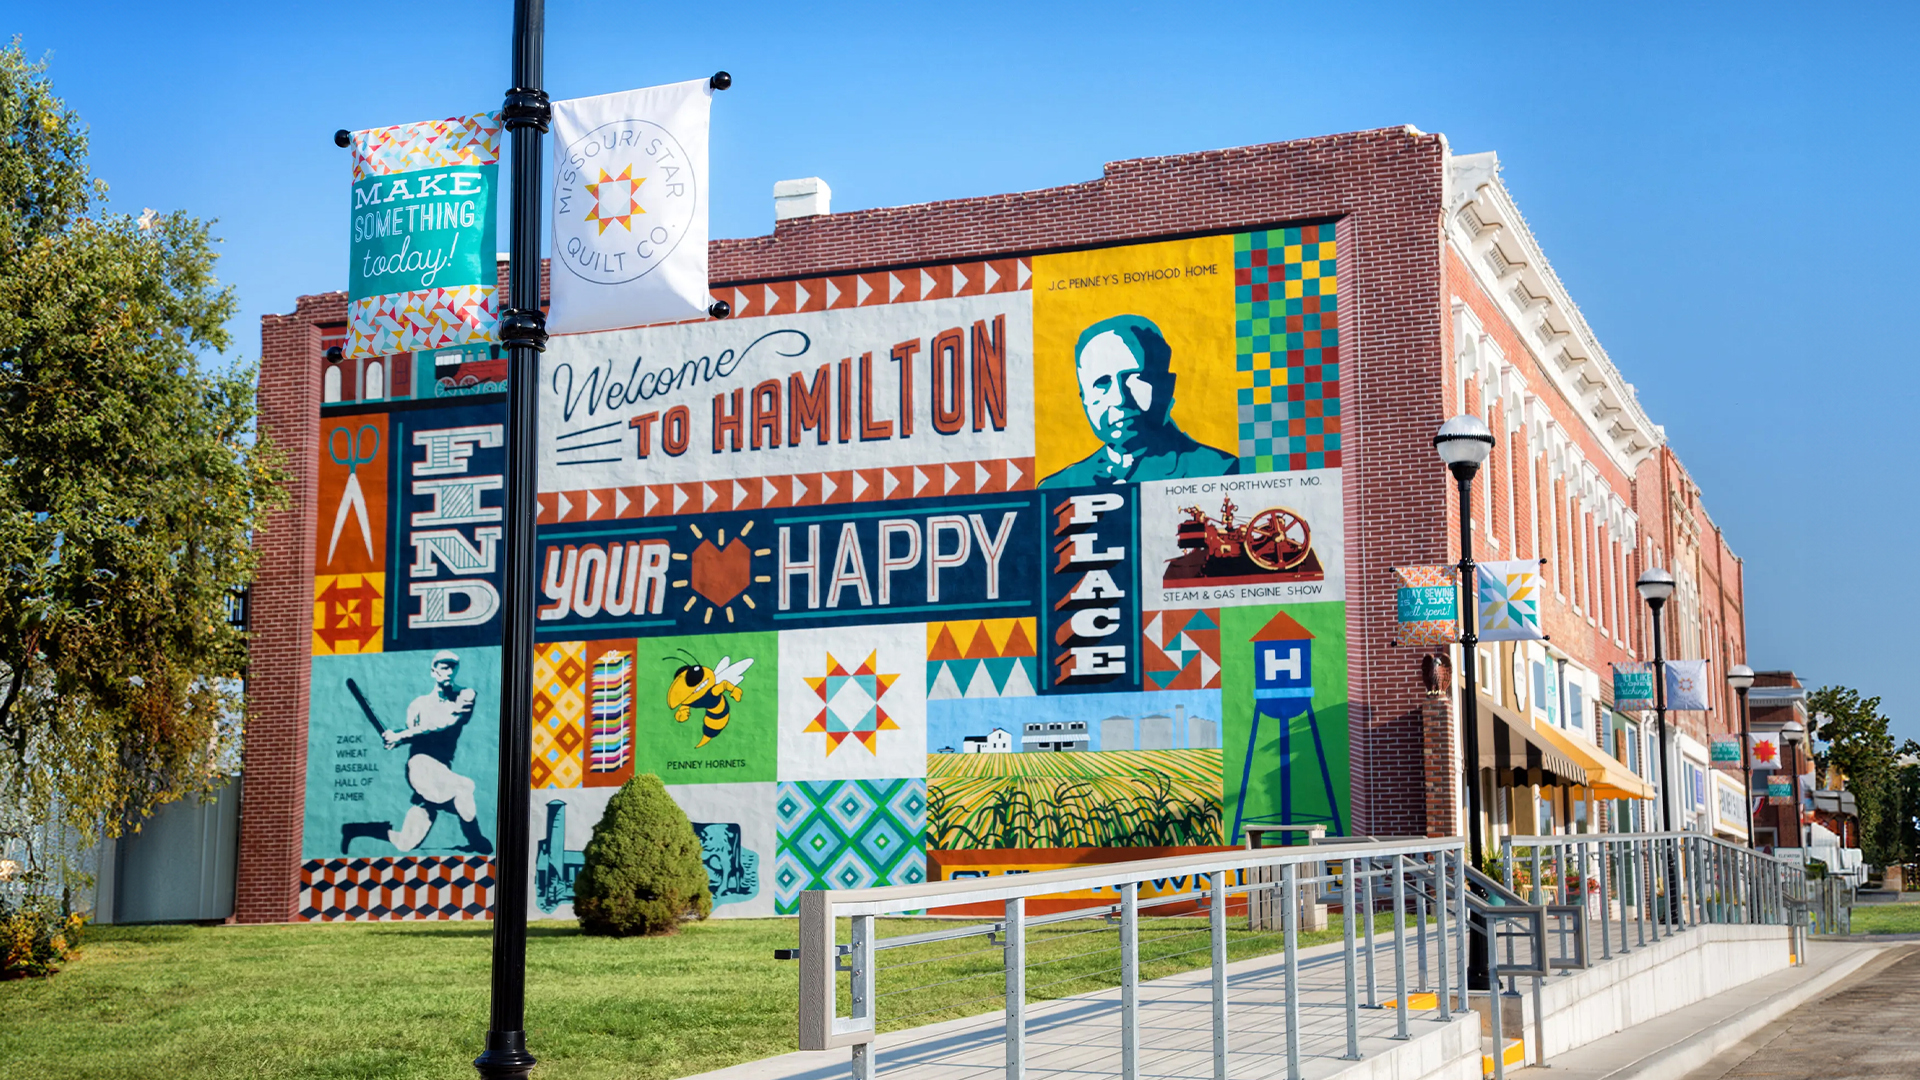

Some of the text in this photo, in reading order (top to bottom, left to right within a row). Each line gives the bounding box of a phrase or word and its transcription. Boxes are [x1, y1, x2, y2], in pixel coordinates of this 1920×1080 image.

[559, 130, 685, 214] MISSOURI STAR
[354, 173, 482, 210] MAKE
[354, 200, 475, 243] SOMETHING
[363, 231, 460, 287] today!
[567, 236, 626, 273] QUILT
[1069, 273, 1119, 290] PENNEY'S
[1123, 267, 1182, 284] BOYHOOD
[1185, 264, 1219, 278] HOME
[552, 328, 811, 423] Welcome
[629, 313, 1008, 459] TO HAMILTON
[1165, 476, 1322, 496] HOME OF NORTHWEST MO.
[408, 424, 504, 629] FIND
[537, 511, 1018, 622] YOUR HAPPY
[1055, 493, 1126, 685] PLACE
[1163, 584, 1324, 602] STEAM & GAS ENGINE SHOW
[1407, 589, 1422, 598] DAY
[1425, 587, 1454, 598] SEWING
[1263, 648, 1301, 681] H
[336, 735, 363, 745] ZACK
[336, 749, 368, 758] WHEAT
[335, 764, 379, 773] BASEBALL
[666, 758, 746, 771] PENNEY HORNETS
[334, 778, 373, 788] HALL OF
[334, 792, 364, 801] FAMER
